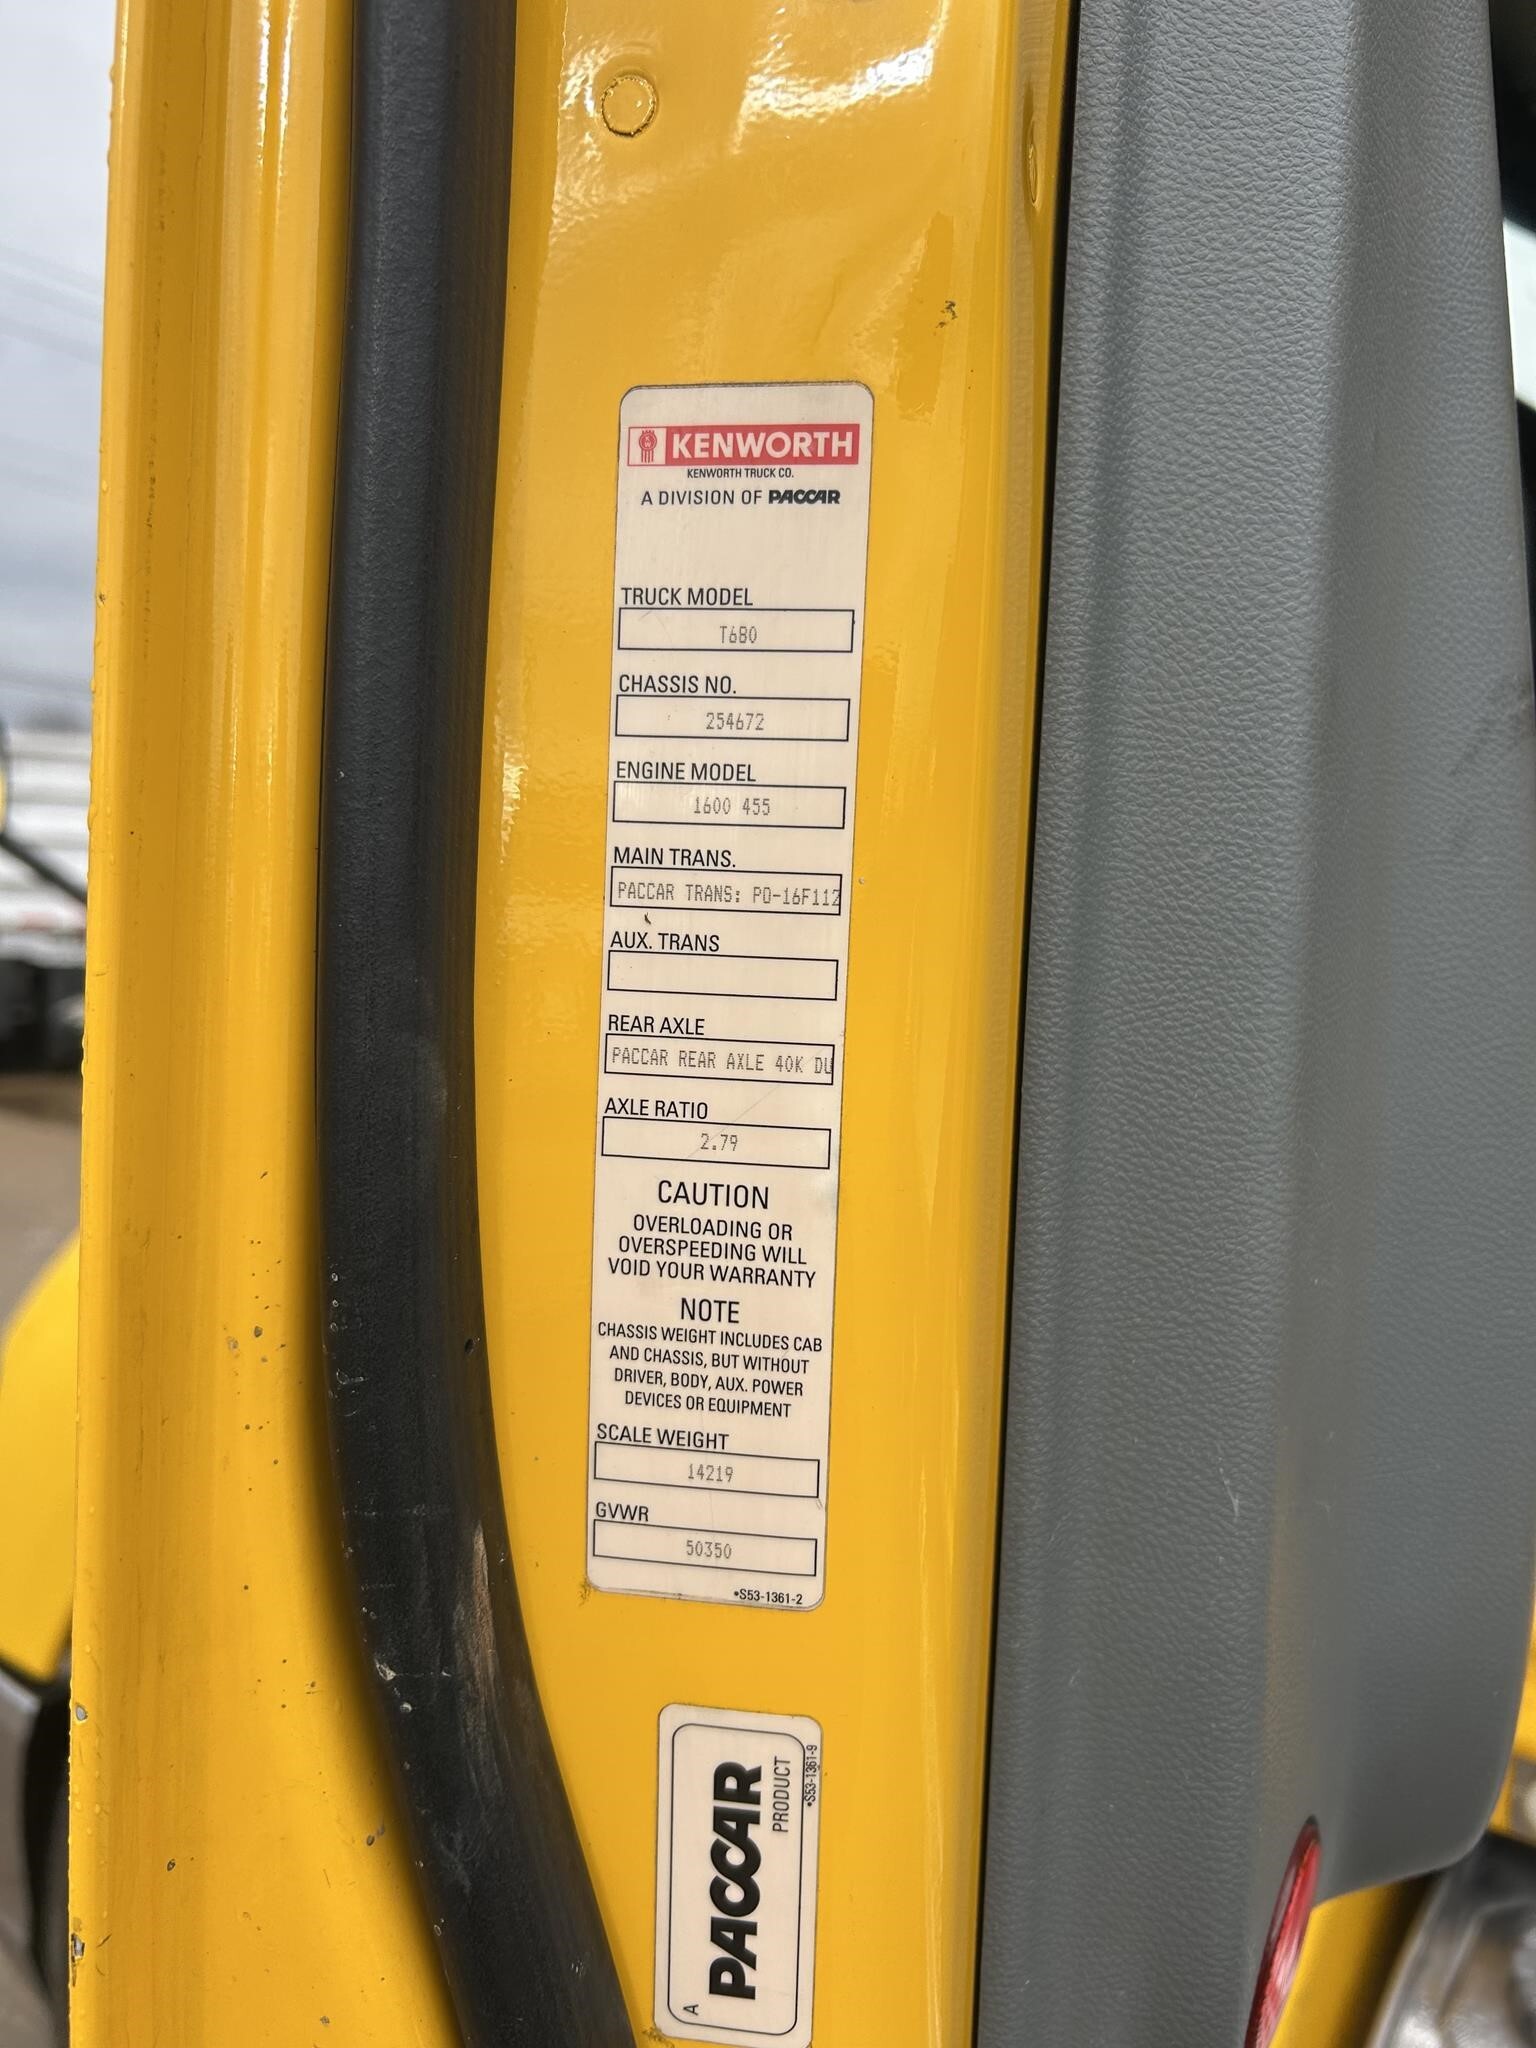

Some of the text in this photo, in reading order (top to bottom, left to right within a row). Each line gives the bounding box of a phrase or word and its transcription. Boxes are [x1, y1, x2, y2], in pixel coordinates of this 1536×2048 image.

[672, 431, 852, 459] KENWORTH
[687, 467, 794, 478] KENWORTH TRUCK CO.
[641, 489, 841, 505] A DIVISION OF PACCAR
[621, 587, 753, 606] TRUCK MODEL
[720, 625, 757, 644] T680
[619, 674, 736, 694] CHASSIS NO.
[706, 712, 764, 731] 254672
[616, 761, 756, 782] ENGINE MODEL
[694, 797, 770, 816] 1600 455
[614, 847, 736, 868] MAIN TRANS.
[618, 881, 674, 900] PACCAR
[686, 884, 740, 903] TRANS:
[610, 931, 720, 952] AUX. TRANS
[608, 1014, 705, 1035] REAR AXLE
[612, 1046, 668, 1066] PACCAR
[679, 1050, 716, 1068] REAR
[726, 1053, 764, 1071] AXLE
[775, 1055, 804, 1073] 40K
[604, 1097, 708, 1120] AXLE RATIO
[700, 1133, 738, 1151] 2.79
[658, 1180, 769, 1209] CAUTION
[634, 1214, 792, 1241] OVERLOADING OR
[619, 1235, 807, 1265] OVERSPEEDING WILL
[608, 1257, 816, 1288] VOID YOUR WARRANTY
[680, 1297, 740, 1324] NOTE
[598, 1322, 823, 1352] CHASSIS WEIGHT INCLUDES CAB
[609, 1345, 810, 1374] AND CHASSIS, BUT WITHOUT
[614, 1368, 803, 1396] DRIVER, BODY, AUX. POWER
[625, 1391, 792, 1417] DEVICES OR EQUIPMENT
[597, 1423, 729, 1450] SCALE WEIGHT
[687, 1463, 734, 1483] 14219
[596, 1501, 649, 1522] GVWR
[686, 1540, 732, 1559] 50350
[772, 1755, 791, 1833] PRODUCT
[709, 1761, 762, 2000] PACCAR
[683, 2004, 699, 2016] A
